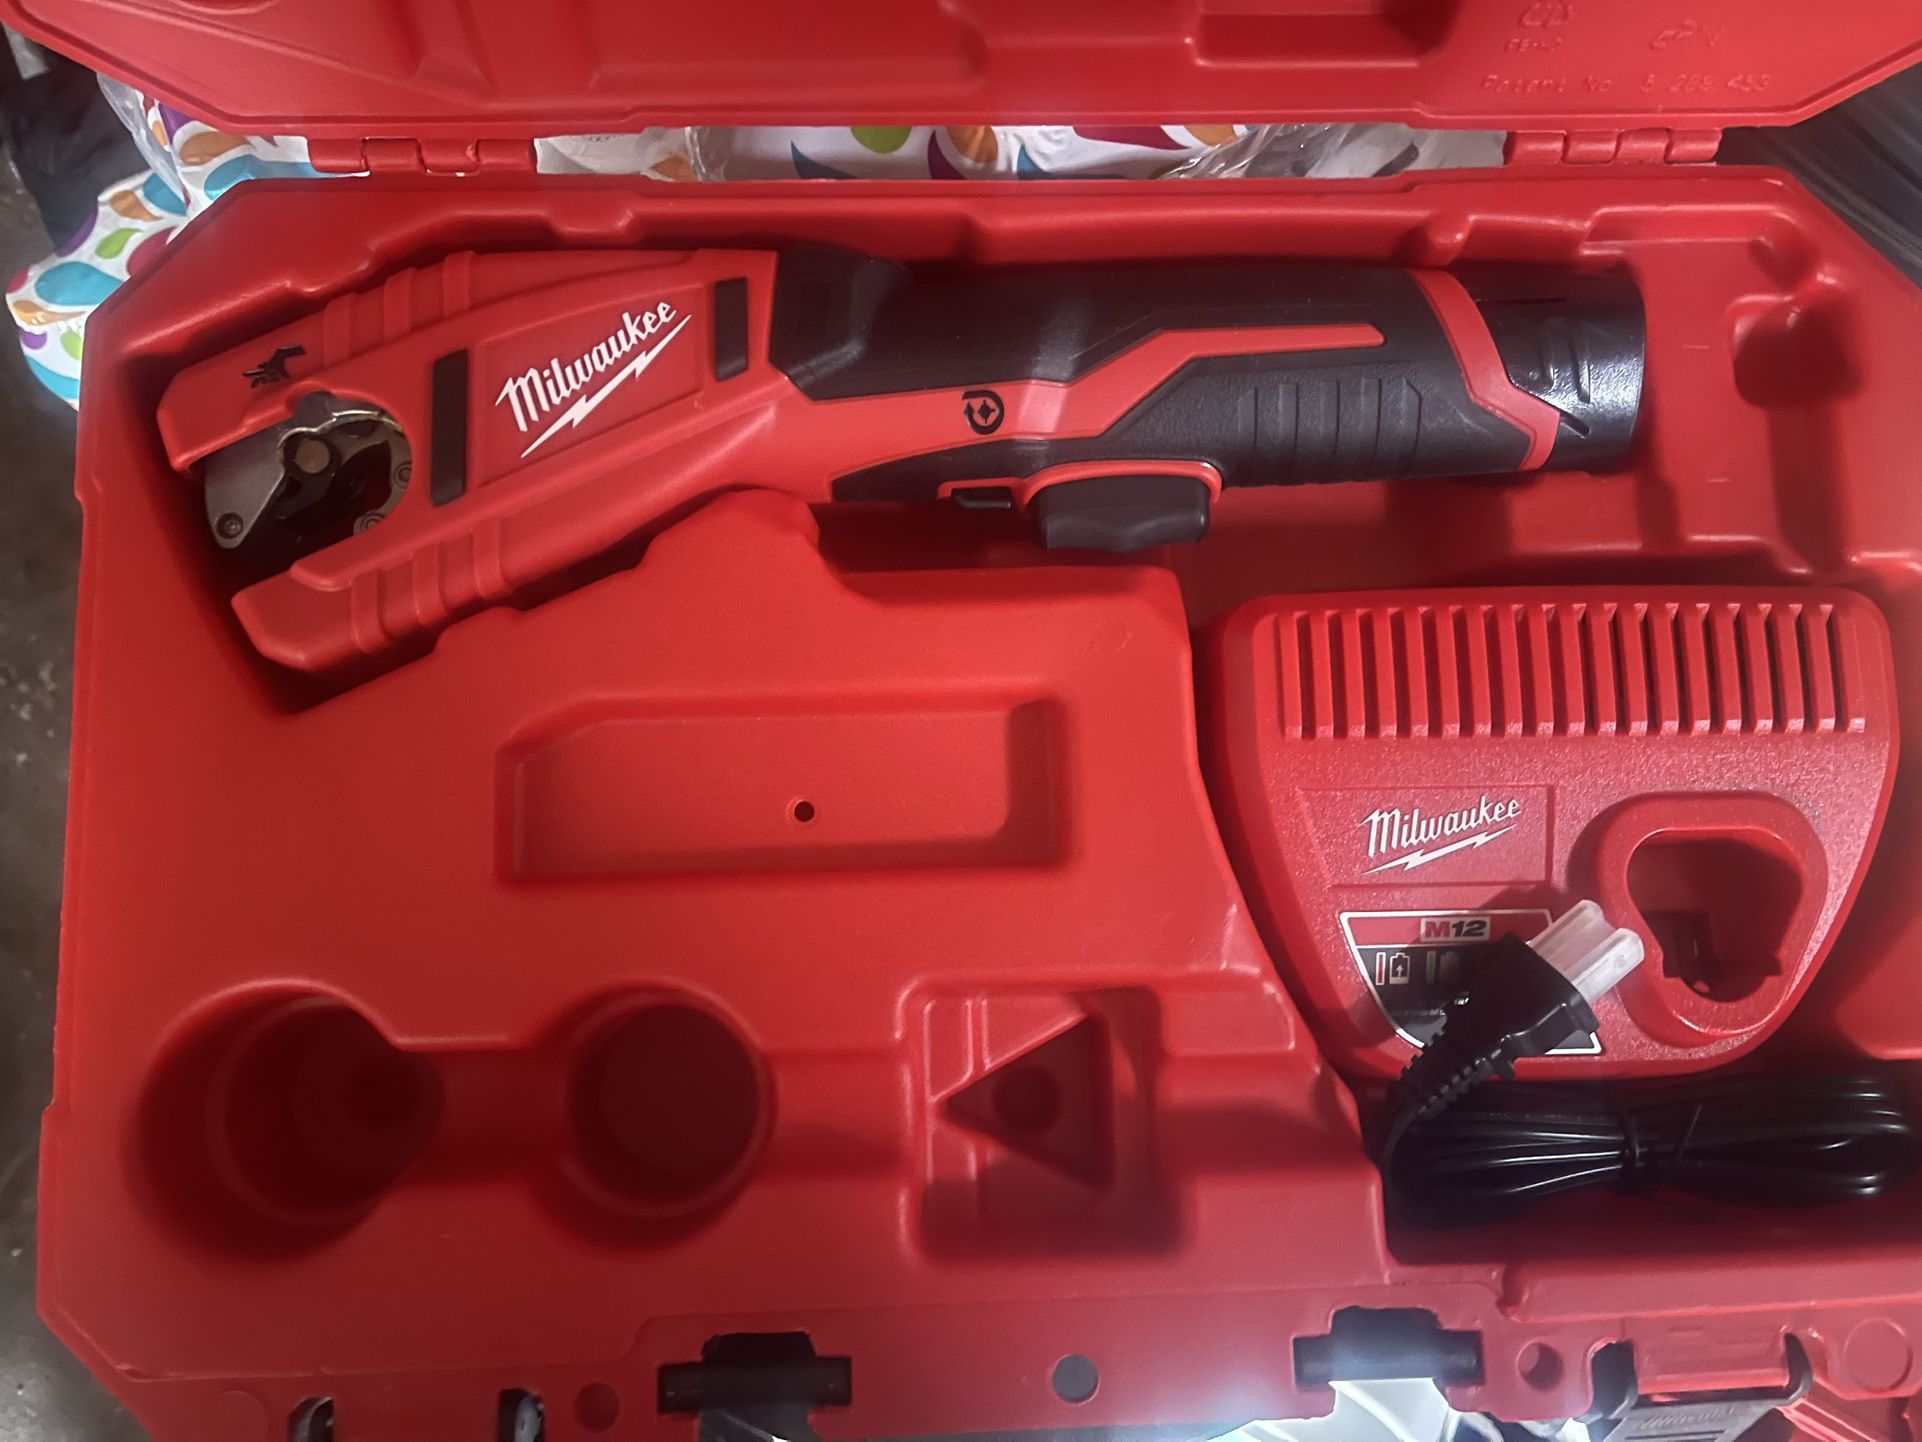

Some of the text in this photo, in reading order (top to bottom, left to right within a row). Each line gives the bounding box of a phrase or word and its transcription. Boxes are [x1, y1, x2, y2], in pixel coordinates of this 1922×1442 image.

[495, 301, 677, 433] Milwaukee
[1358, 795, 1522, 858] Milwaukee
[1424, 920, 1488, 938] M12
